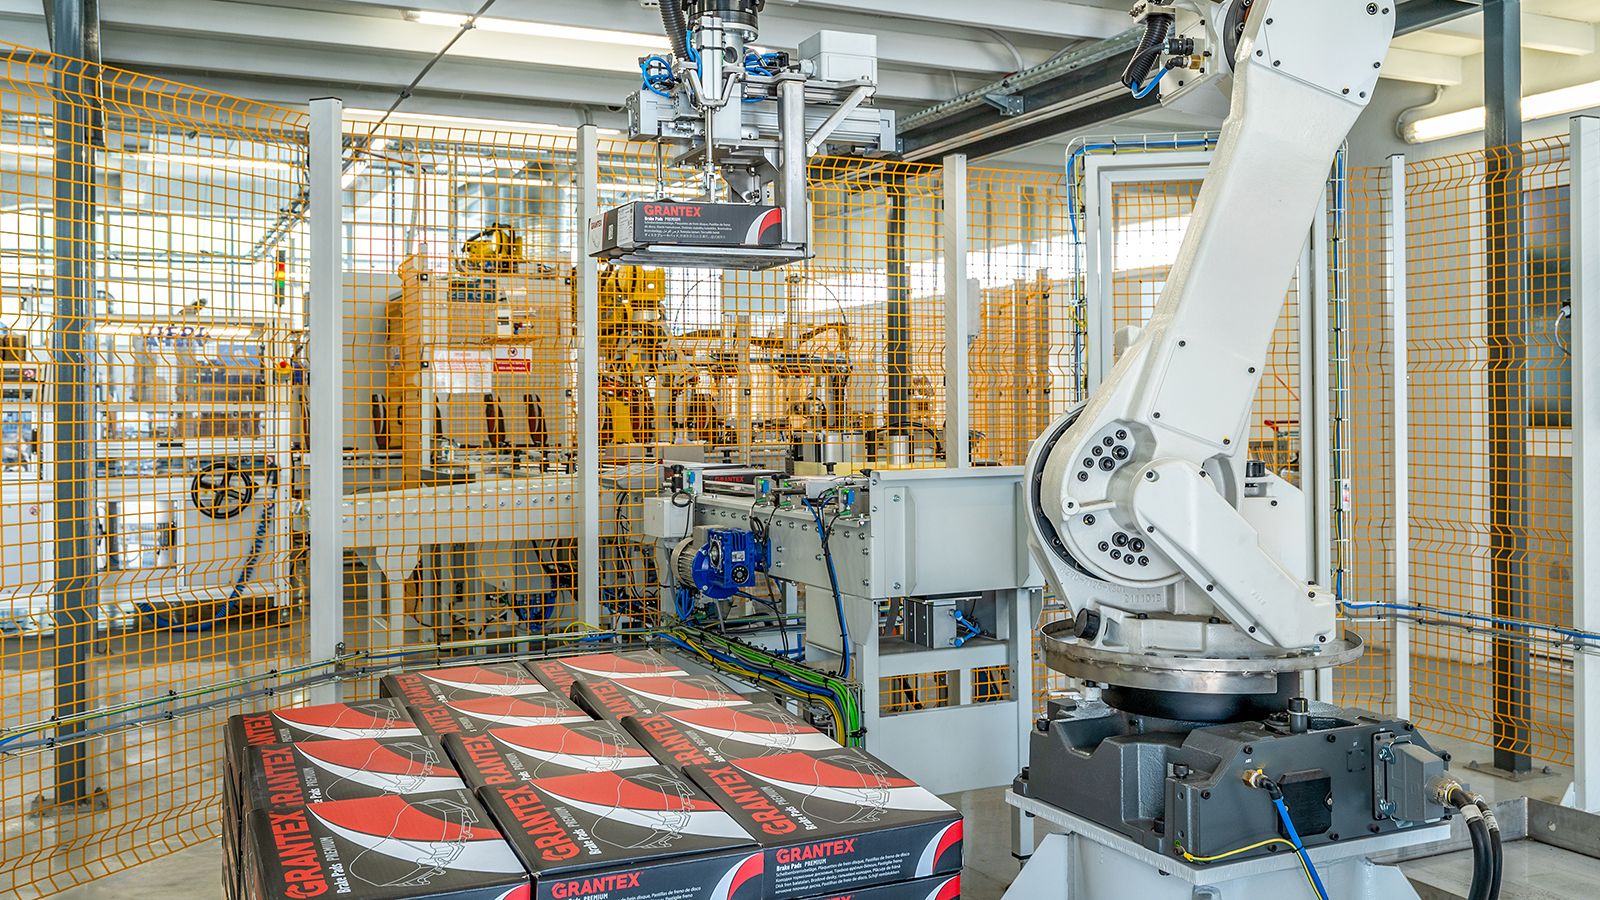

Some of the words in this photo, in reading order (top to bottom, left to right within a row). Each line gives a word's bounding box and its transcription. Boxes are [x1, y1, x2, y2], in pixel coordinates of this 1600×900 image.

[643, 204, 702, 217] GRANTEX
[460, 733, 517, 785] RANTEX
[702, 766, 797, 835] GRANTEX
[785, 805, 803, 817] Pads
[497, 784, 581, 861] GRANTEX
[797, 816, 818, 831] Brake
[572, 828, 591, 840] Pads
[268, 809, 329, 899] GRANTEX
[319, 836, 340, 862] PREMIUM
[583, 840, 602, 855] Brake
[775, 838, 856, 864] GRANTEX
[328, 863, 346, 878] Pads
[776, 864, 790, 872] Brake
[791, 862, 802, 870] Pads
[804, 858, 827, 867] PREMIUM
[334, 877, 352, 894] Brake
[551, 871, 641, 899] GRANTEX
